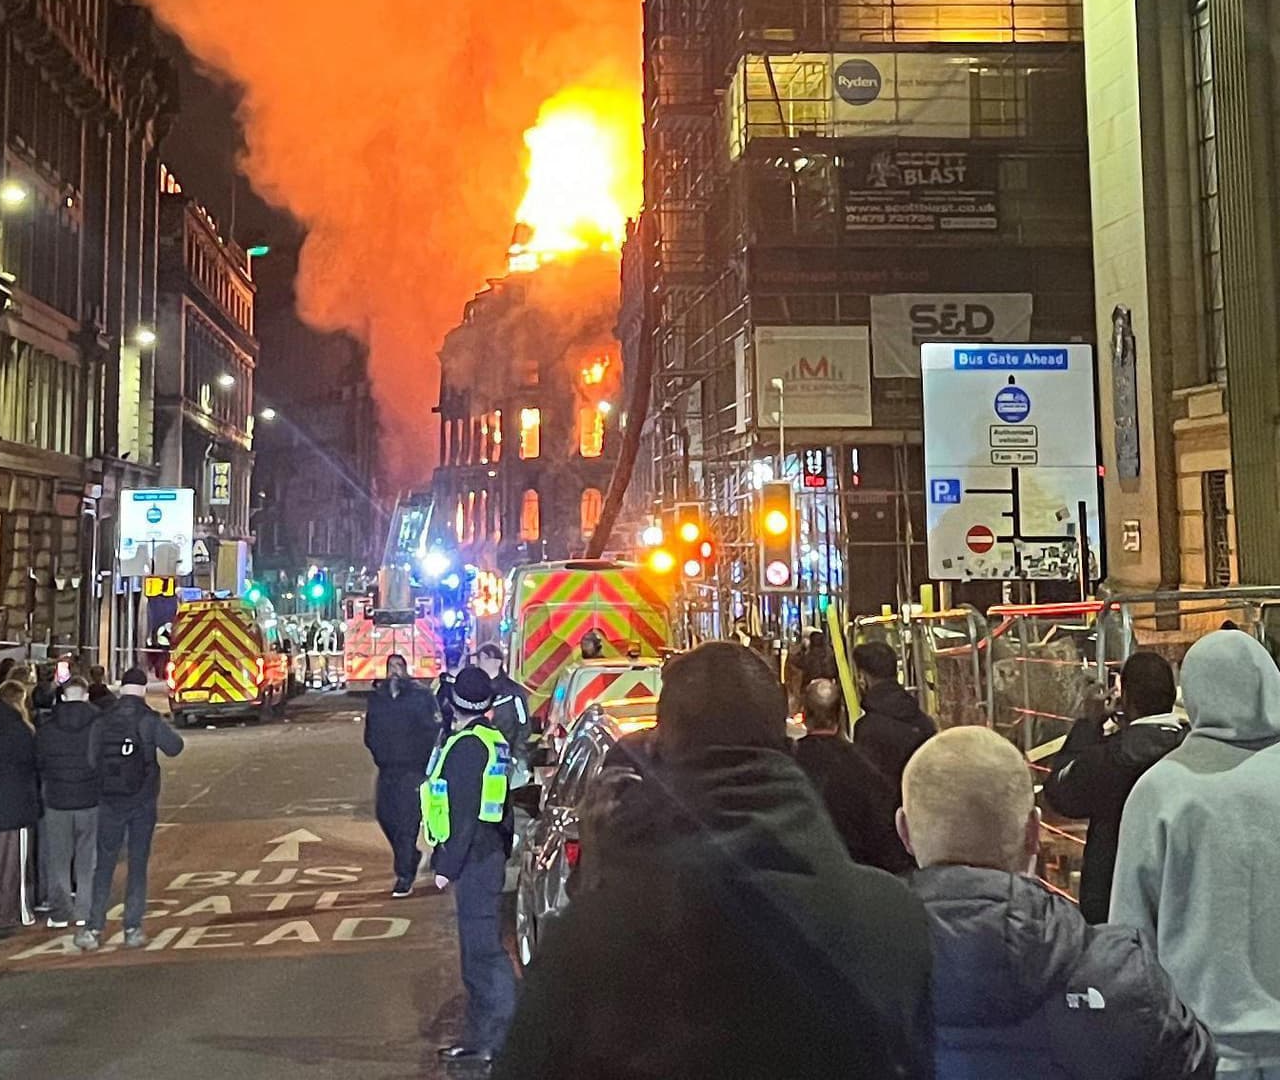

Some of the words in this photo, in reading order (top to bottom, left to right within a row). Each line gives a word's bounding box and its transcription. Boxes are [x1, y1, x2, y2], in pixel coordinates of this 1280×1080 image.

[838, 74, 879, 89] Ryden
[903, 166, 968, 186] BLAST
[958, 352, 984, 366] Bus
[987, 352, 1019, 366] Gate
[1023, 352, 1064, 366] Ahead
[934, 481, 950, 502] P
[165, 866, 364, 891] BUS
